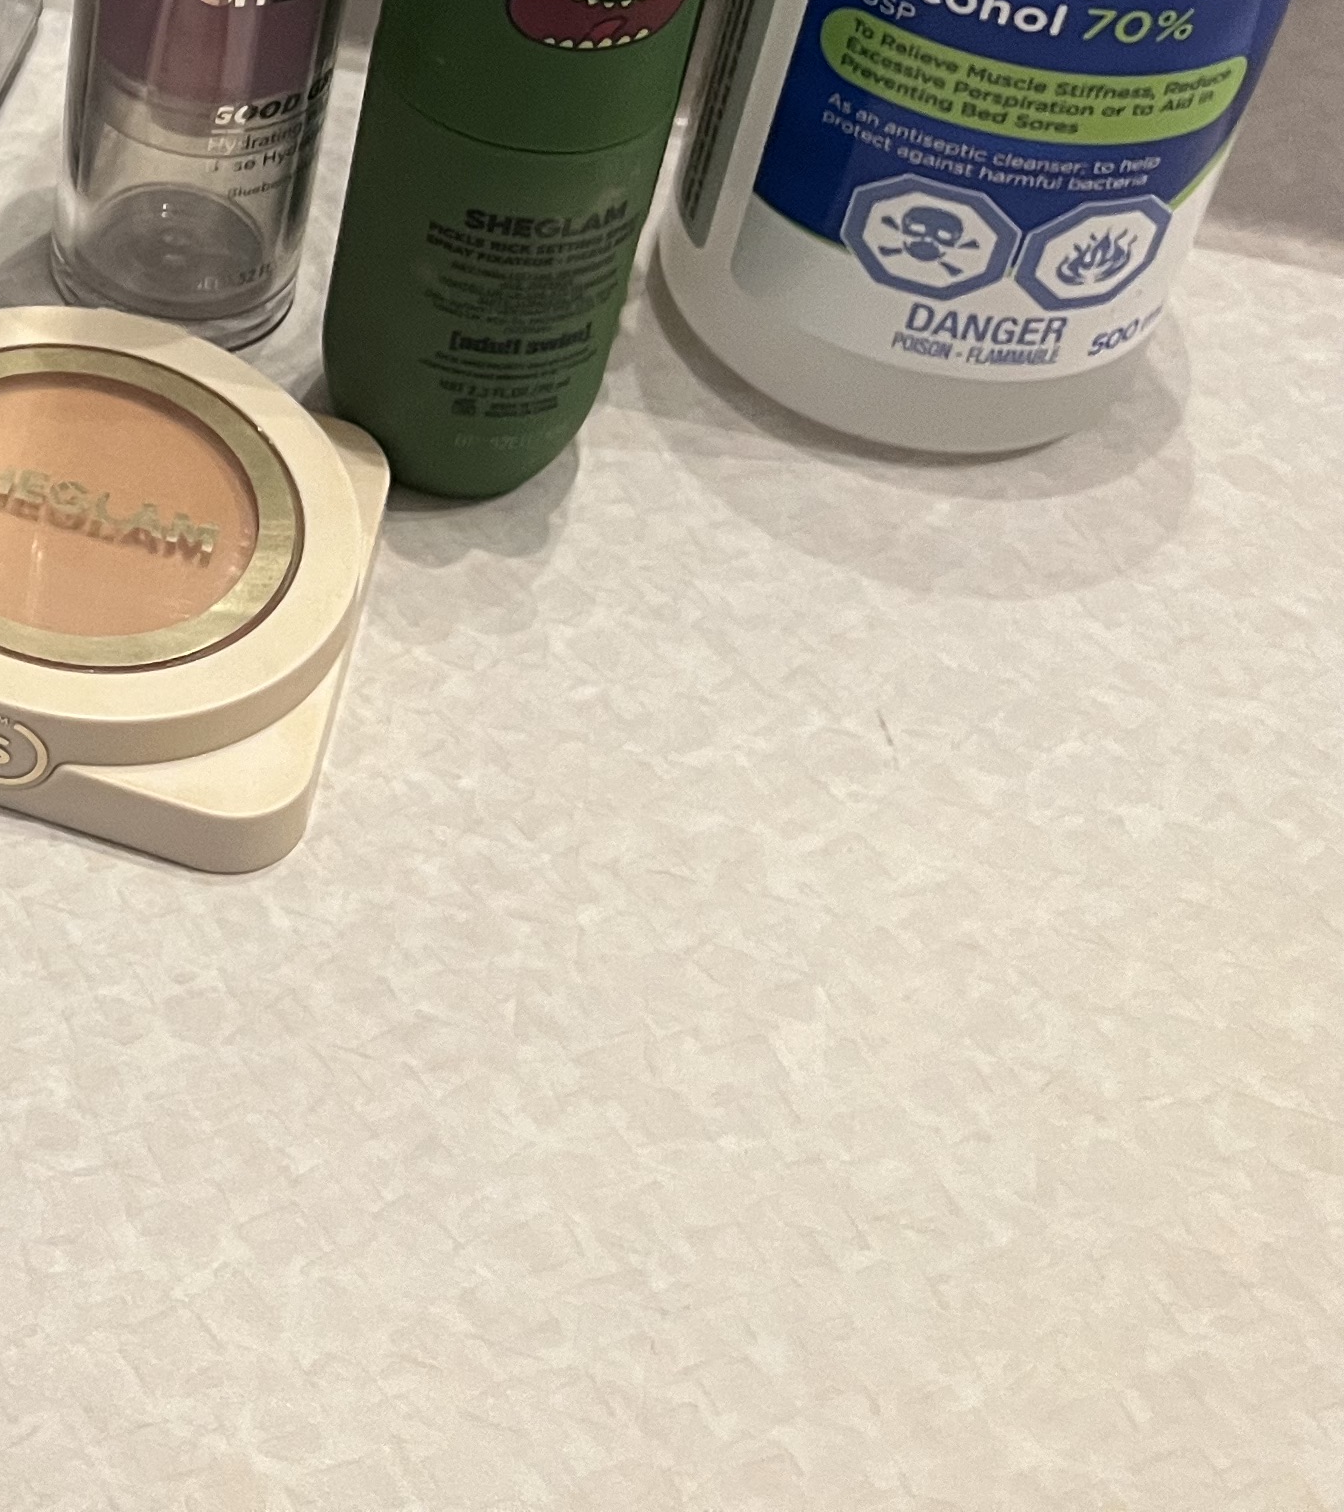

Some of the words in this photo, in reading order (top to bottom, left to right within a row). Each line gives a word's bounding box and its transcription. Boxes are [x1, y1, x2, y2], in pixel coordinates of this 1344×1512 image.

[1082, 7, 1197, 46] 70%
[845, 36, 948, 91] Excessive
[953, 78, 1095, 118] Perspiration
[1101, 104, 1127, 118] or
[1132, 101, 1155, 117] to
[1160, 91, 1195, 114] Aid
[853, 18, 875, 40] To
[880, 31, 960, 75] Relieve
[966, 63, 1048, 95] Muscle
[1054, 81, 1157, 102] Stiffness,
[839, 51, 955, 115] Preventing
[960, 101, 1009, 126] Bed
[1014, 113, 1079, 135] Sores
[822, 108, 894, 153] protect
[896, 143, 976, 180] against
[978, 165, 1063, 191] harmful
[1067, 173, 1149, 193] bacteria
[827, 92, 853, 116] As
[855, 108, 881, 130] an
[884, 120, 989, 164] antiseptic
[1092, 159, 1115, 176] to
[1119, 155, 1162, 174] help
[465, 200, 628, 239] SHEGLAM
[891, 330, 955, 360] POISON
[905, 301, 1069, 347] DANGER
[1087, 317, 1140, 357] 500
